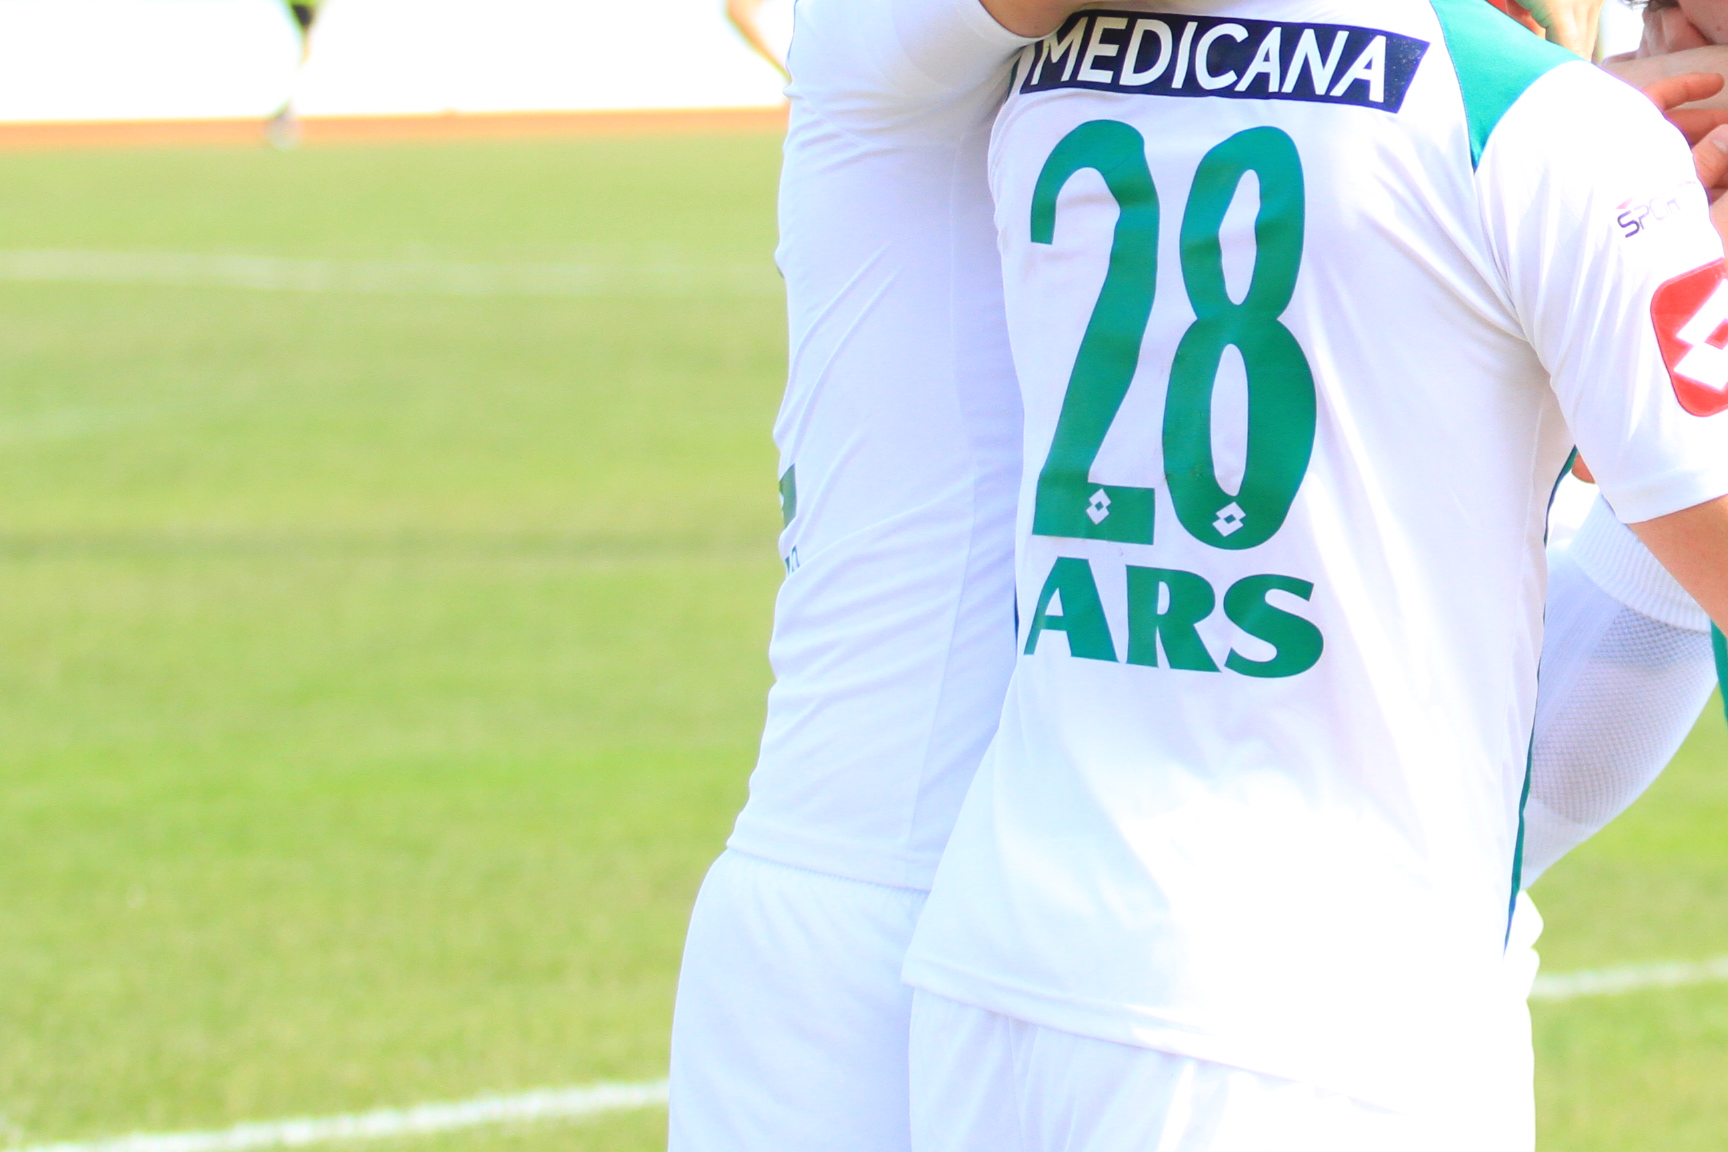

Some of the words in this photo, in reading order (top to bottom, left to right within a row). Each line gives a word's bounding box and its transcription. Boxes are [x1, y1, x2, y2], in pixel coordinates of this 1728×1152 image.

[1031, 16, 1388, 103] MEDICANA
[1030, 119, 1317, 550] 28
[1024, 556, 1324, 678] ARS
